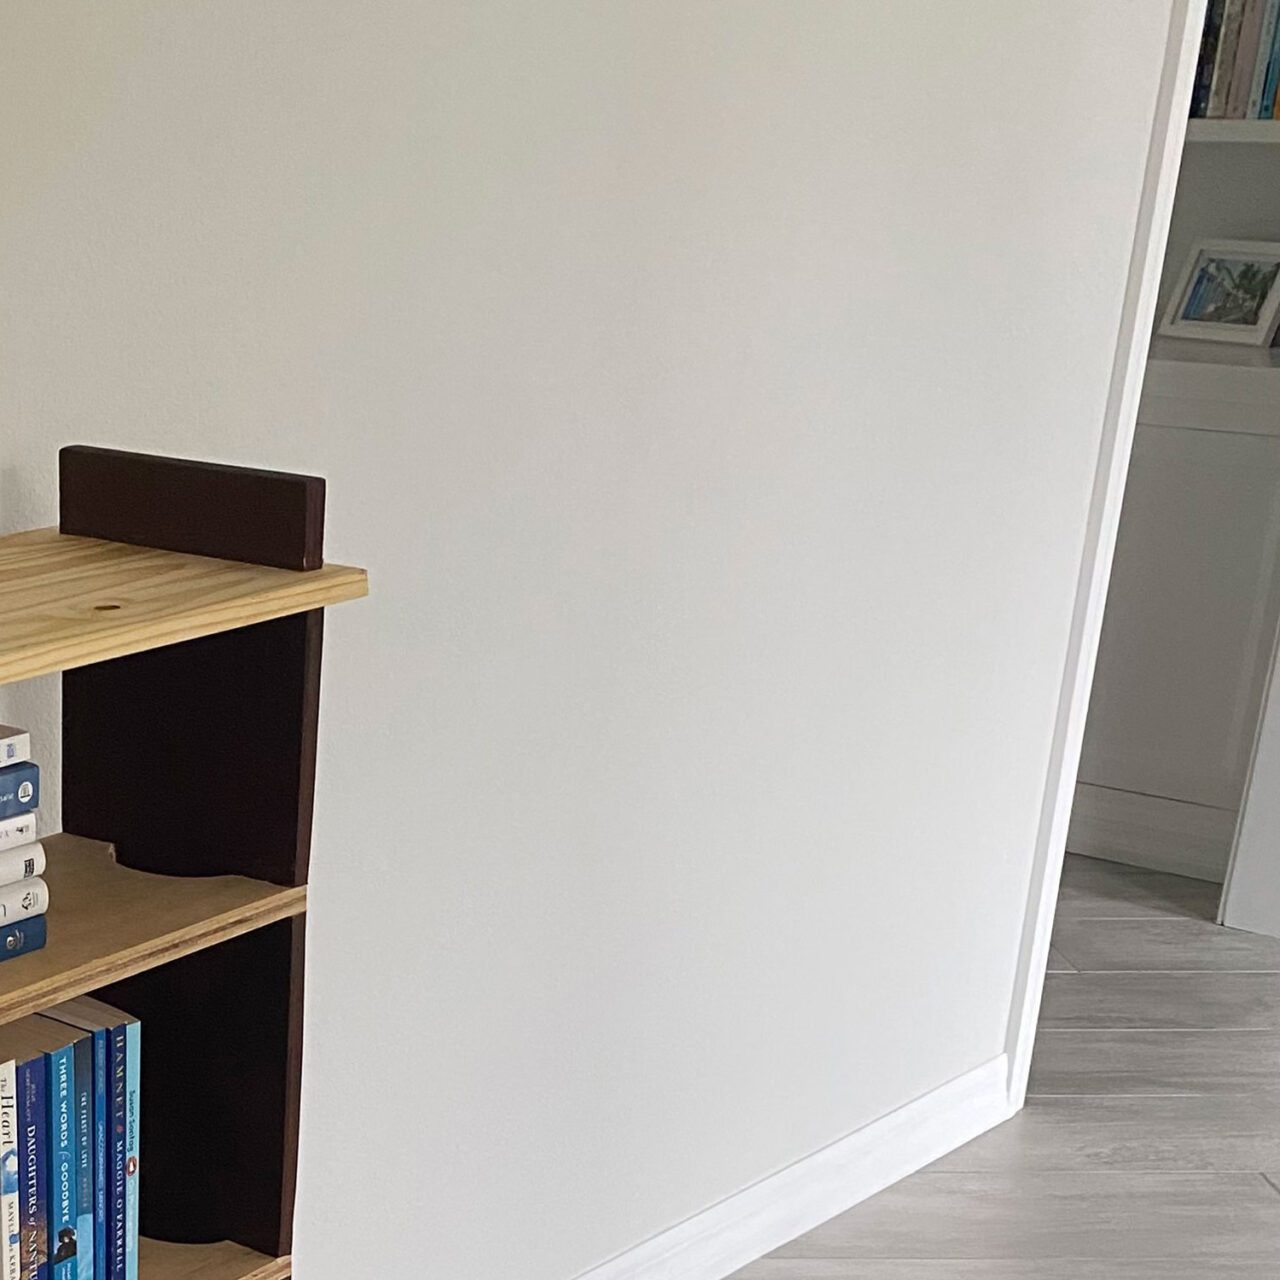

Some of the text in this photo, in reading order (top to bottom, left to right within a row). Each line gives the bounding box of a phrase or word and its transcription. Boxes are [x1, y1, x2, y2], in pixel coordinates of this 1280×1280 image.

[59, 1055, 67, 1098] THREE
[116, 1035, 124, 1118] HAMNET
[0, 1077, 14, 1146] The Heart
[59, 1100, 68, 1148] WORDS
[127, 1090, 136, 1153] Susan Sontag
[27, 1125, 38, 1214] DAUGHTERS
[60, 1162, 69, 1223] GOODBYE
[116, 1199, 124, 1272] O'FARRELL
